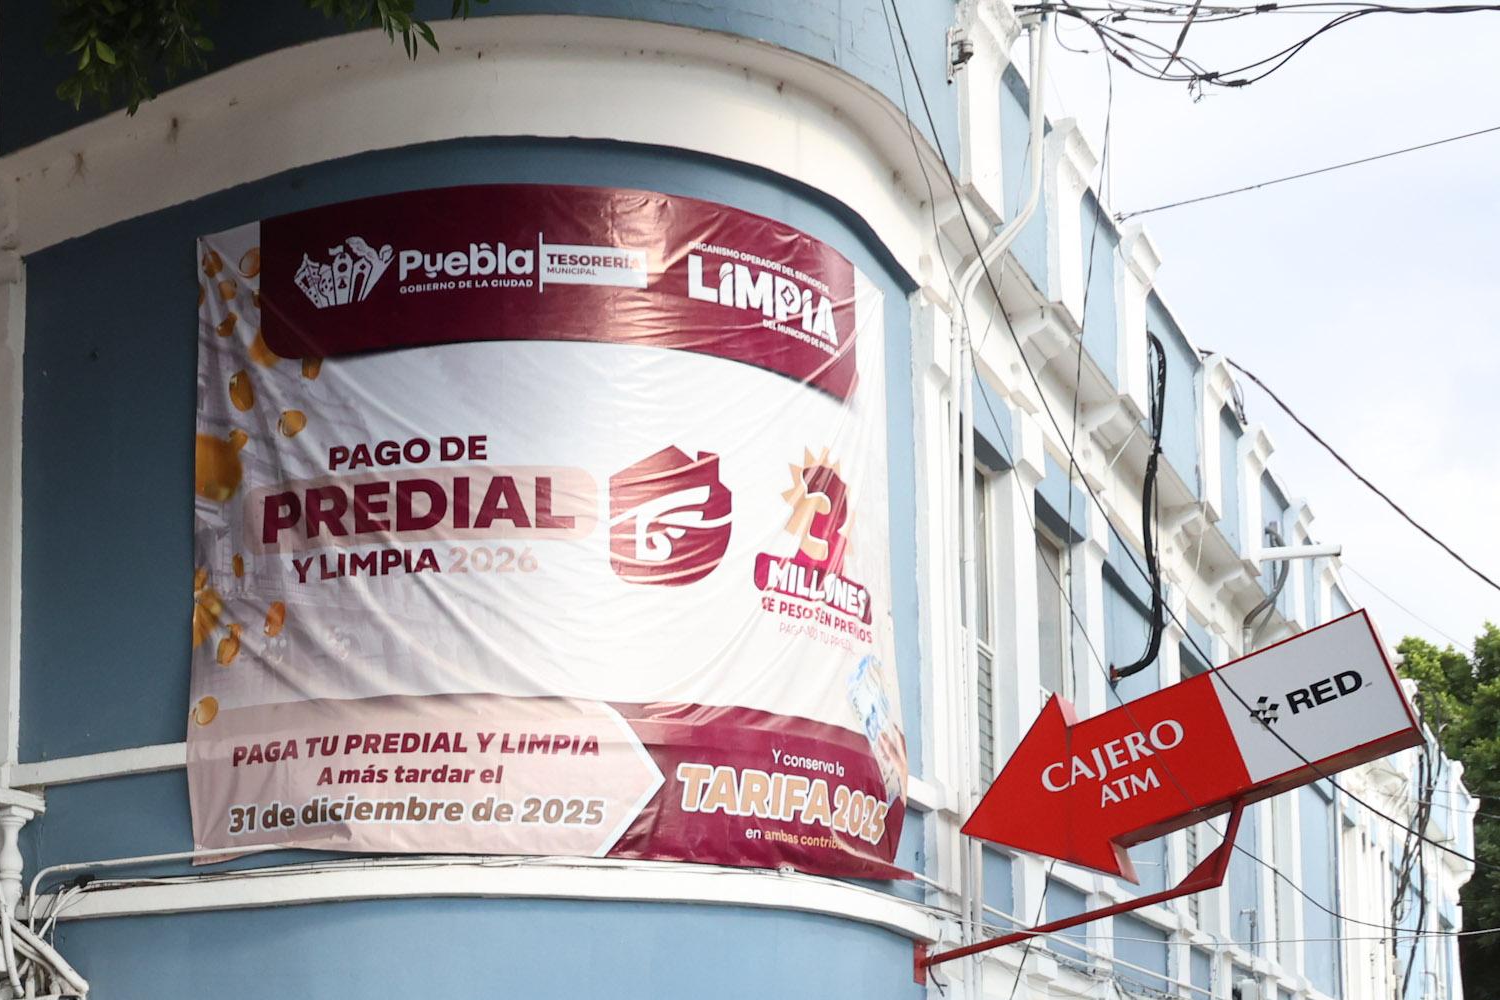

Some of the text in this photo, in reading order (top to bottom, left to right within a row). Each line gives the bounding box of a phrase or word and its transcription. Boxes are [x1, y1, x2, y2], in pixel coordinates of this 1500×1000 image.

[399, 242, 534, 281] Puebla
[547, 266, 597, 276] MUNICIPAL
[687, 240, 740, 259] ORGANISMO
[740, 252, 782, 272] OPERADOR
[781, 264, 796, 278] DEL
[400, 278, 533, 294] GOBIERNO DE LA CIUDAD
[762, 318, 777, 331] DEL
[777, 323, 812, 344] MUNICIPIO
[810, 336, 820, 348] DE
[328, 435, 487, 471] PAGO DE
[262, 475, 576, 544] PREDIAL
[292, 546, 539, 584] Y LIMPIA 2026
[766, 559, 868, 622] MILLONES
[1286, 669, 1363, 715] RED
[232, 732, 600, 768] PAGA TU PREDIAL Y LIMPIA
[772, 748, 845, 777] Y conserva la
[1041, 719, 1185, 793] CAJERO
[316, 763, 504, 786] A más tardar el
[1100, 768, 1161, 808] ATM
[229, 794, 605, 834] 31 de diciembre de 2025
[677, 762, 889, 846] TARIFA 2025
[745, 827, 762, 840] en
[764, 829, 799, 844] ambas
